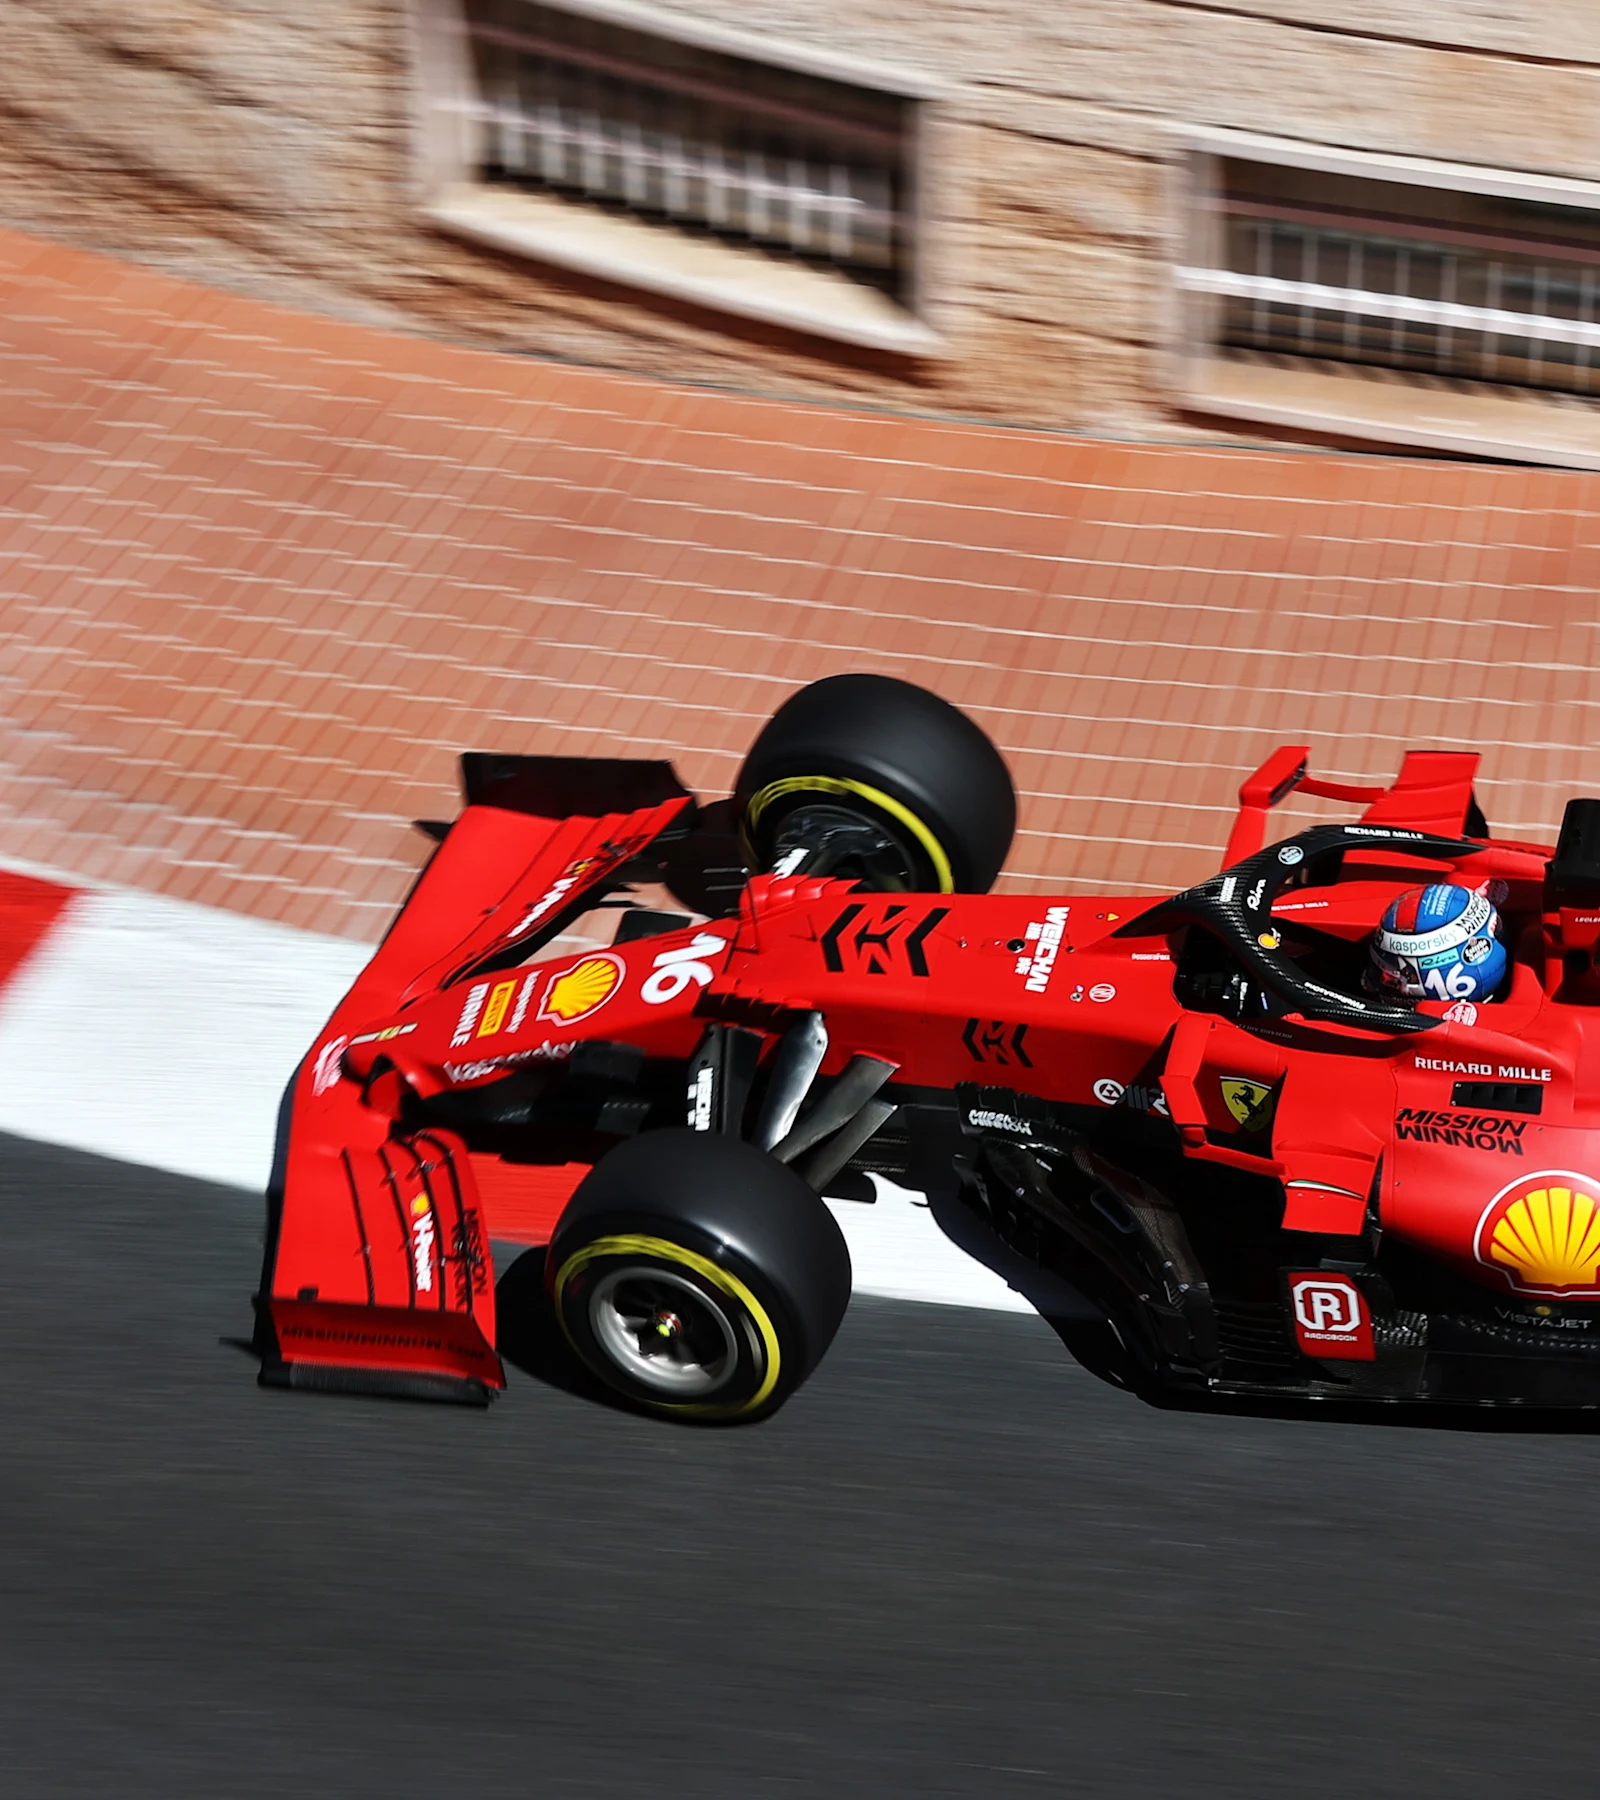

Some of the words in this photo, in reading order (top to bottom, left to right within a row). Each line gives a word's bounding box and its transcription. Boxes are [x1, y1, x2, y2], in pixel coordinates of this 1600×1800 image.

[1344, 826, 1391, 838] RICHARD
[1392, 829, 1424, 840] MILLE
[1247, 879, 1267, 911] Riva
[1025, 906, 1071, 993] WEICHAI
[1389, 931, 1458, 954] kaspersky
[640, 932, 727, 1004] 16
[1420, 954, 1459, 968] Riva
[1424, 962, 1477, 1001] 16
[450, 982, 491, 1049] MAHLE
[1416, 1056, 1492, 1077] RICHARD
[1498, 1064, 1552, 1082] MILLE
[1396, 1108, 1527, 1138] MISSION
[1396, 1123, 1525, 1156] WINNOW
